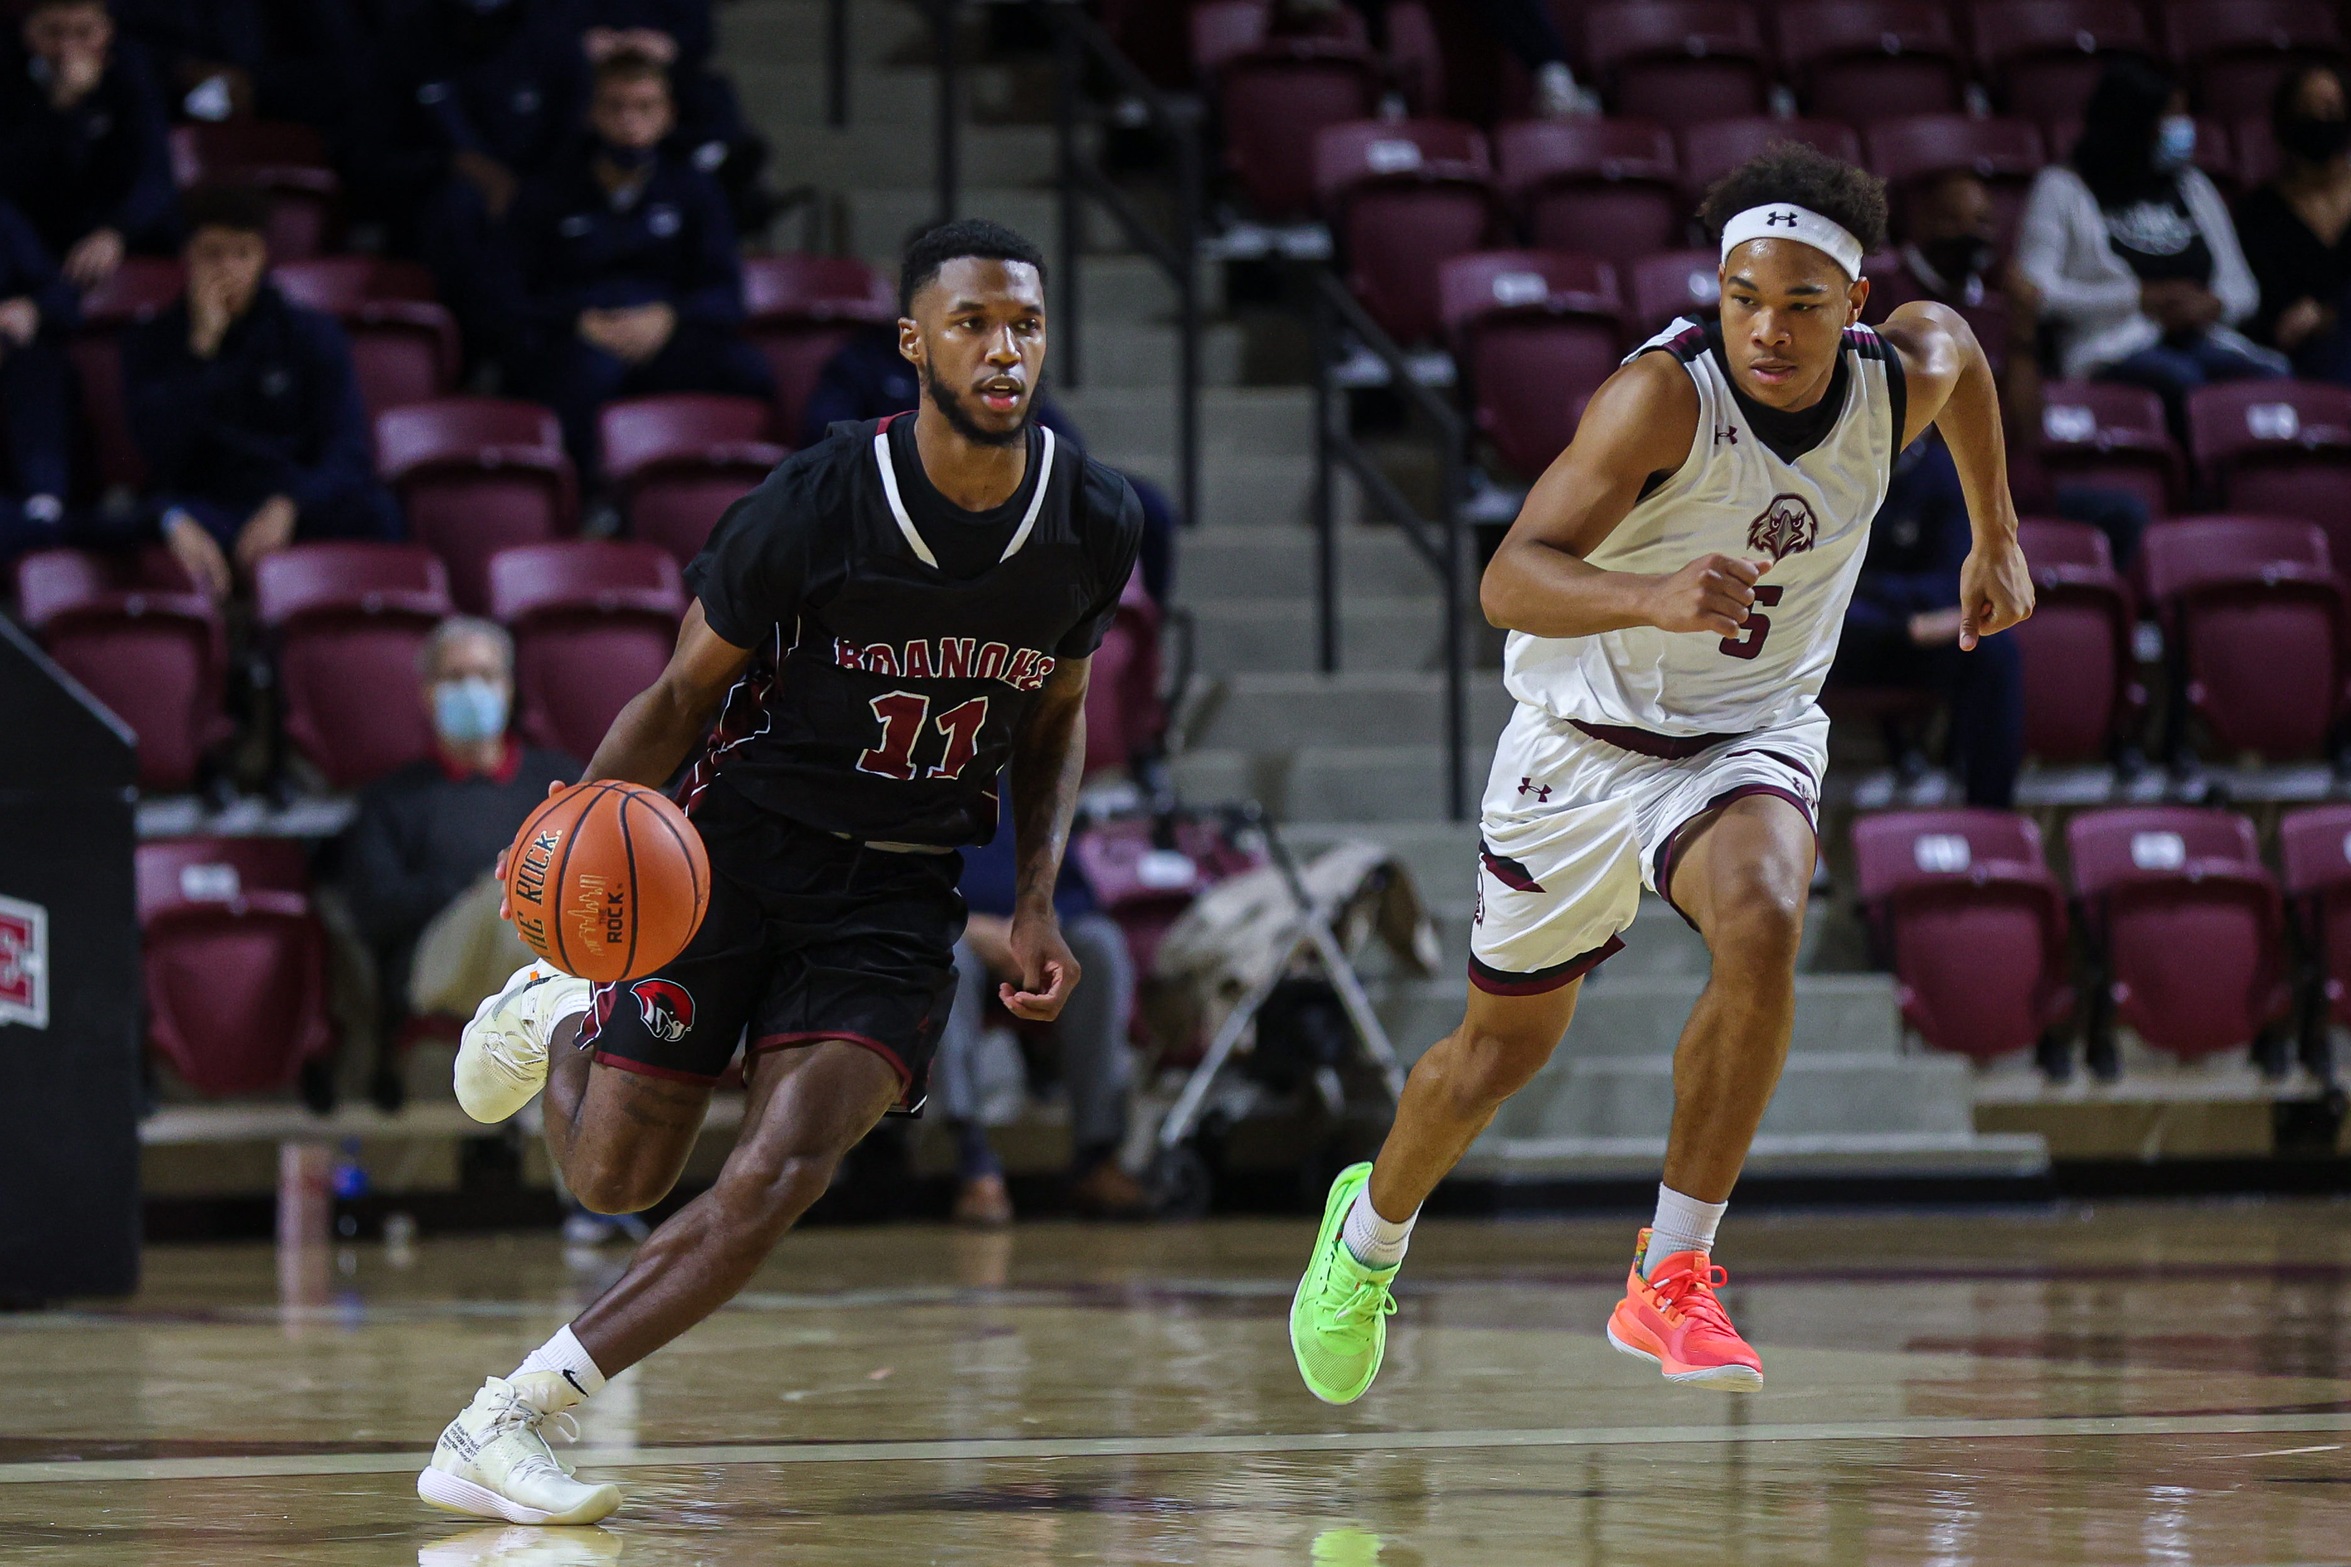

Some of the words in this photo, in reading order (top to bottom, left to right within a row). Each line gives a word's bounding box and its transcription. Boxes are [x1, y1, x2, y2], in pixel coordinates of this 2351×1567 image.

[1719, 585, 1784, 660] 5
[856, 690, 988, 780] 11
[517, 910, 553, 961] HE
[607, 891, 624, 943] ROCK
